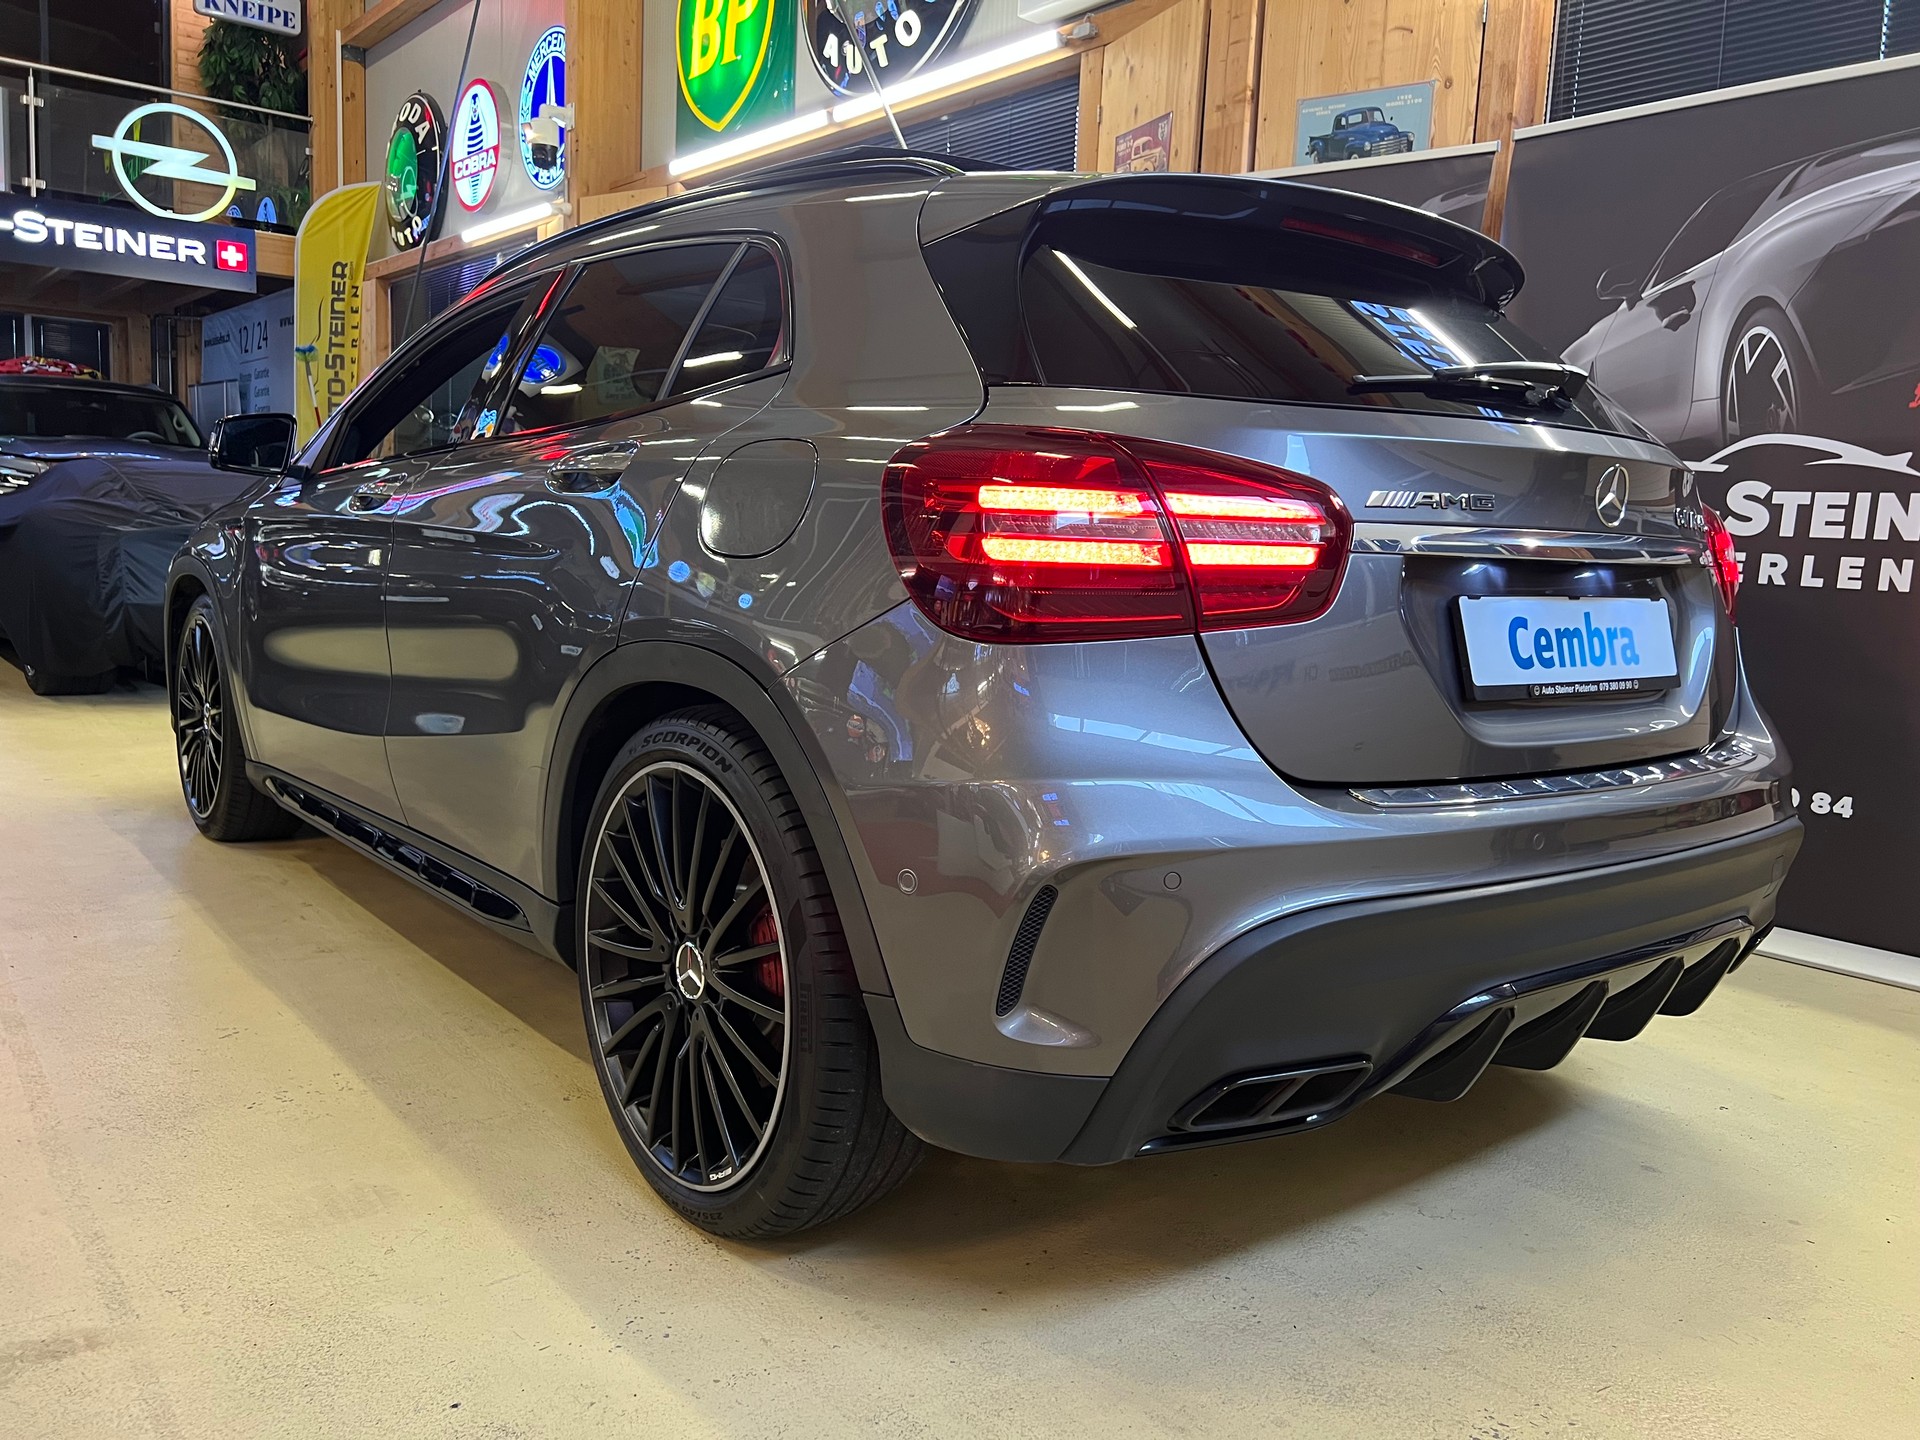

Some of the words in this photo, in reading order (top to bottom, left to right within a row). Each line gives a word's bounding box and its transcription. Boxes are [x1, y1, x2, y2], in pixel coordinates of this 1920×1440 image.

[688, 0, 757, 80] BP
[823, 9, 922, 74] AUTO
[454, 148, 496, 180] COBRA
[391, 215, 424, 246] AUTO
[1411, 491, 1495, 511] AMG
[1508, 611, 1640, 670] Cembra
[1541, 685, 1555, 695] Auto
[1555, 684, 1575, 694] Steiner
[1575, 683, 1598, 693] Pieterlen
[641, 731, 733, 773] SCORPION
[1810, 791, 1853, 818] 84
